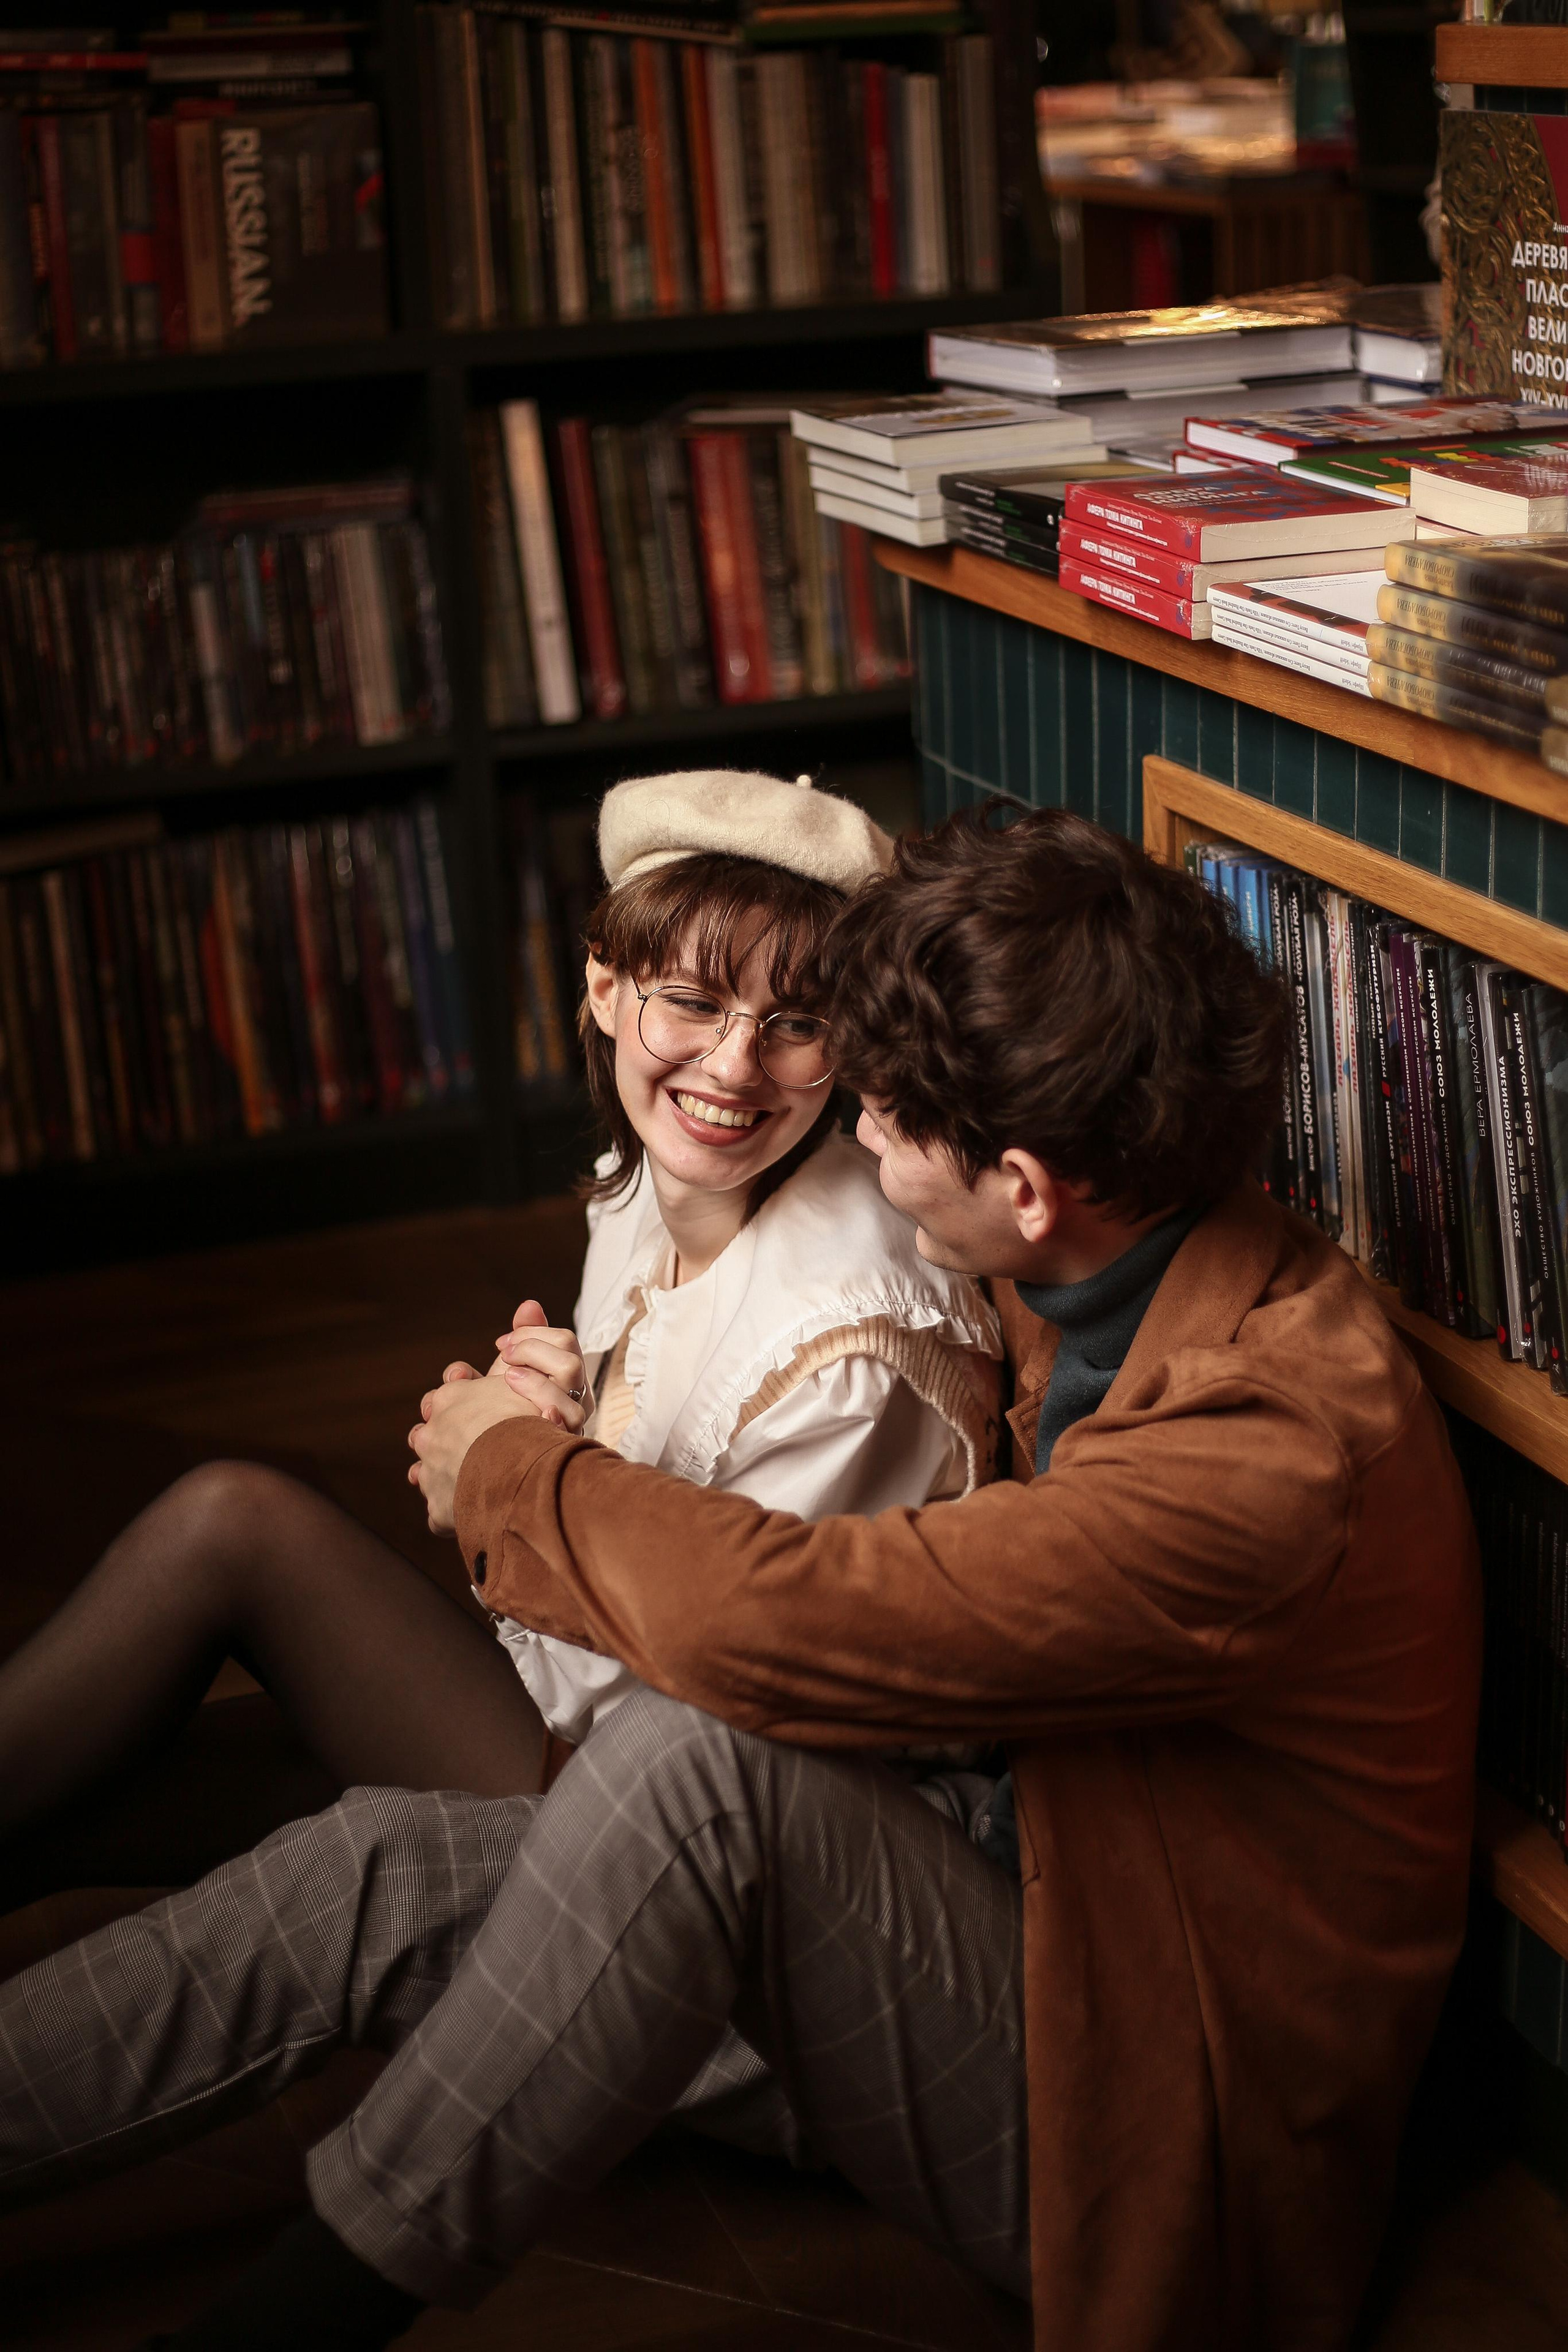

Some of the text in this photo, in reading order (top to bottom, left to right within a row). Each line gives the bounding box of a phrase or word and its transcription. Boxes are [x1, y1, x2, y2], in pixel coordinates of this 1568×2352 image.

[1511, 239, 1568, 270] ДЕРЕВЯ
[1370, 944, 1383, 1034] КУБОФУТУРИЗМ
[1296, 985, 1314, 1135] БОРИСОВ-МУСАТОВ
[1404, 1048, 1412, 1103] СОВРЕМЕННОМ
[1427, 968, 1456, 1226] ОБЩЕСТВО ХУДОЖНИКОВ СОЮЗ МОЛОДЕЖИ
[1465, 993, 1485, 1137] ВЕРА ЕРМОЛАЕВА
[1385, 1101, 1395, 1160] ФУТУРИЗМ
[1498, 1055, 1518, 1205] ЭКСПРЕССИОНИЗМА
[1513, 1012, 1548, 1279] ОБЩЕСТВО ХУДОЖНИКОВ СОЮЗ МОЛОДЕЖИ
[1391, 1164, 1401, 1227] ИТАЛЬЯНСКИЙ
